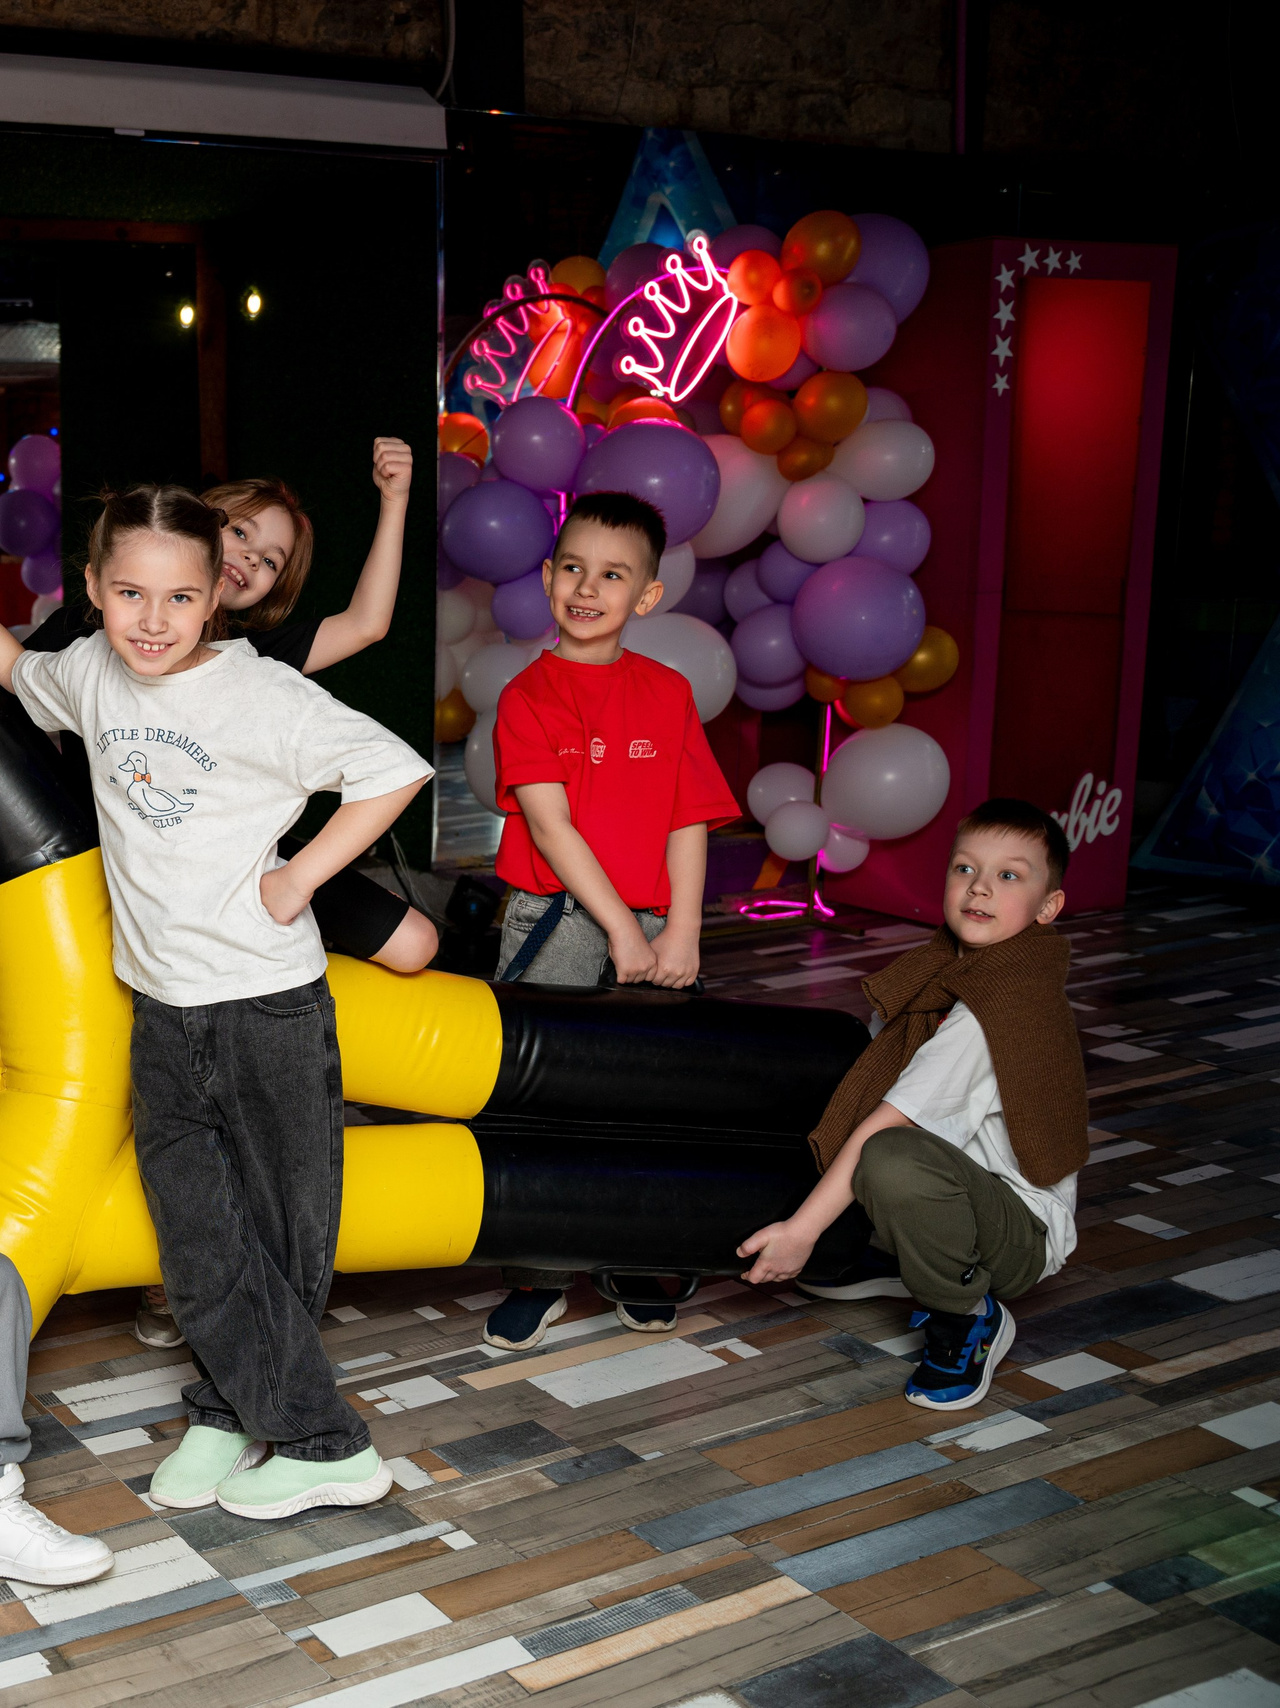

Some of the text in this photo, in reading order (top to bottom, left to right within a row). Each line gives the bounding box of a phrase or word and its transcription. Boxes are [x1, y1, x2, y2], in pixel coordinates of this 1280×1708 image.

[96, 727, 218, 772] LITTLE DREAMERS
[152, 816, 183, 829] CLUB
